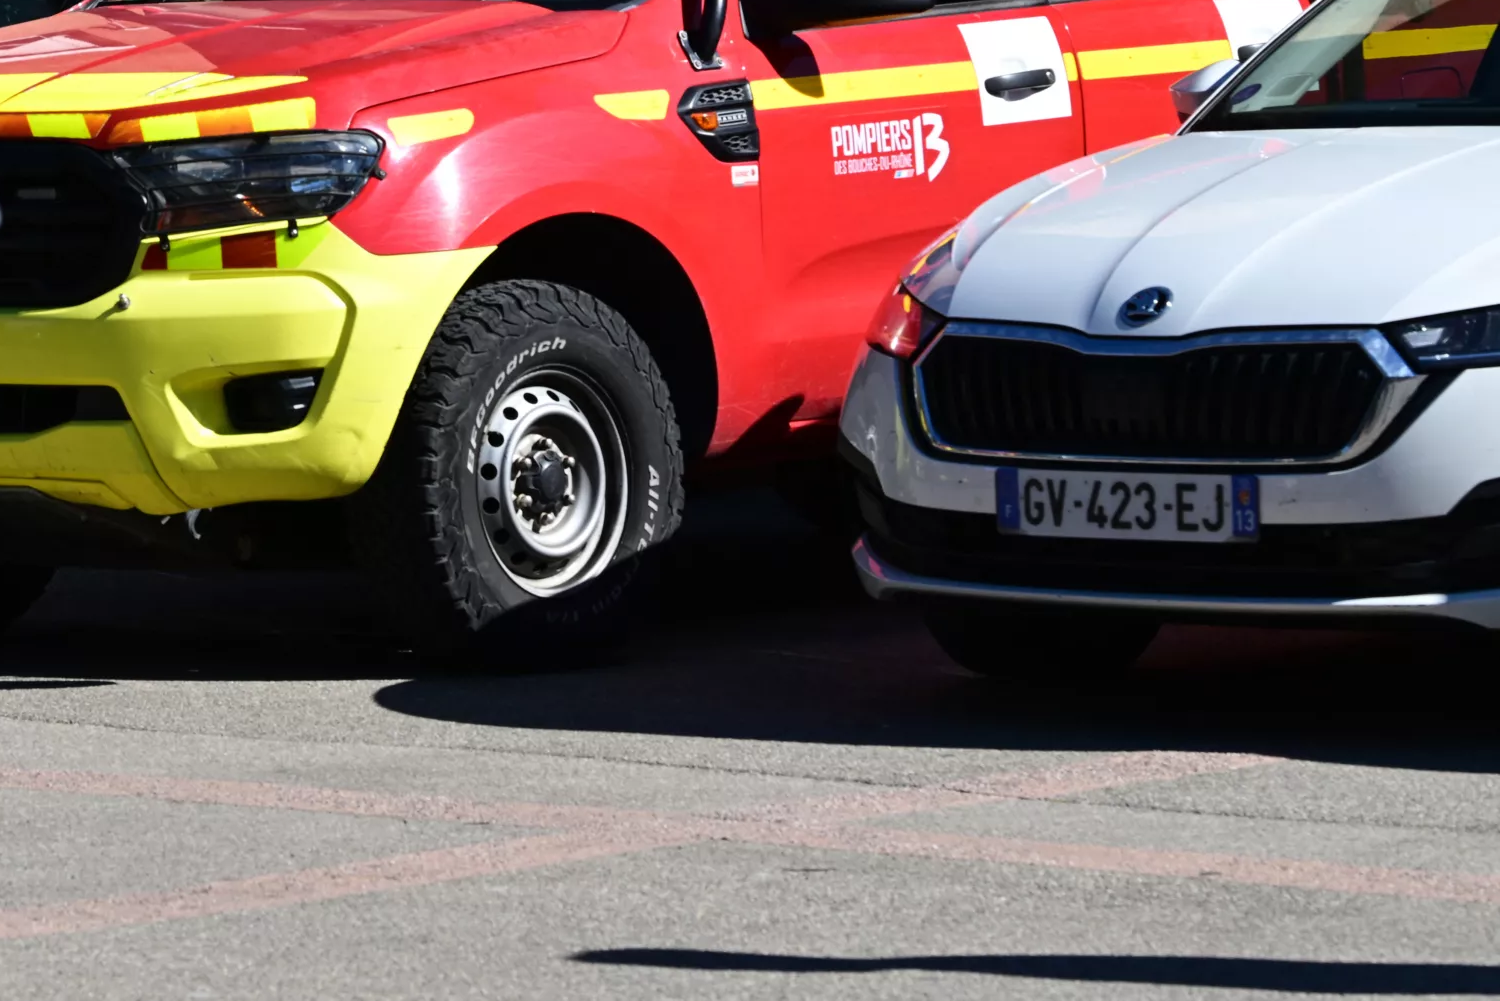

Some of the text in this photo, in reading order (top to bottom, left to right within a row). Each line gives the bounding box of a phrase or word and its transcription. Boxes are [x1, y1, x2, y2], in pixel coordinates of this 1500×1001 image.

[831, 112, 951, 183] POMPIERS 13
[834, 160, 847, 175] DES
[466, 337, 567, 475] BFGoodrich
[1023, 477, 1226, 533] GV-423-EJ
[1235, 508, 1256, 533] 13
